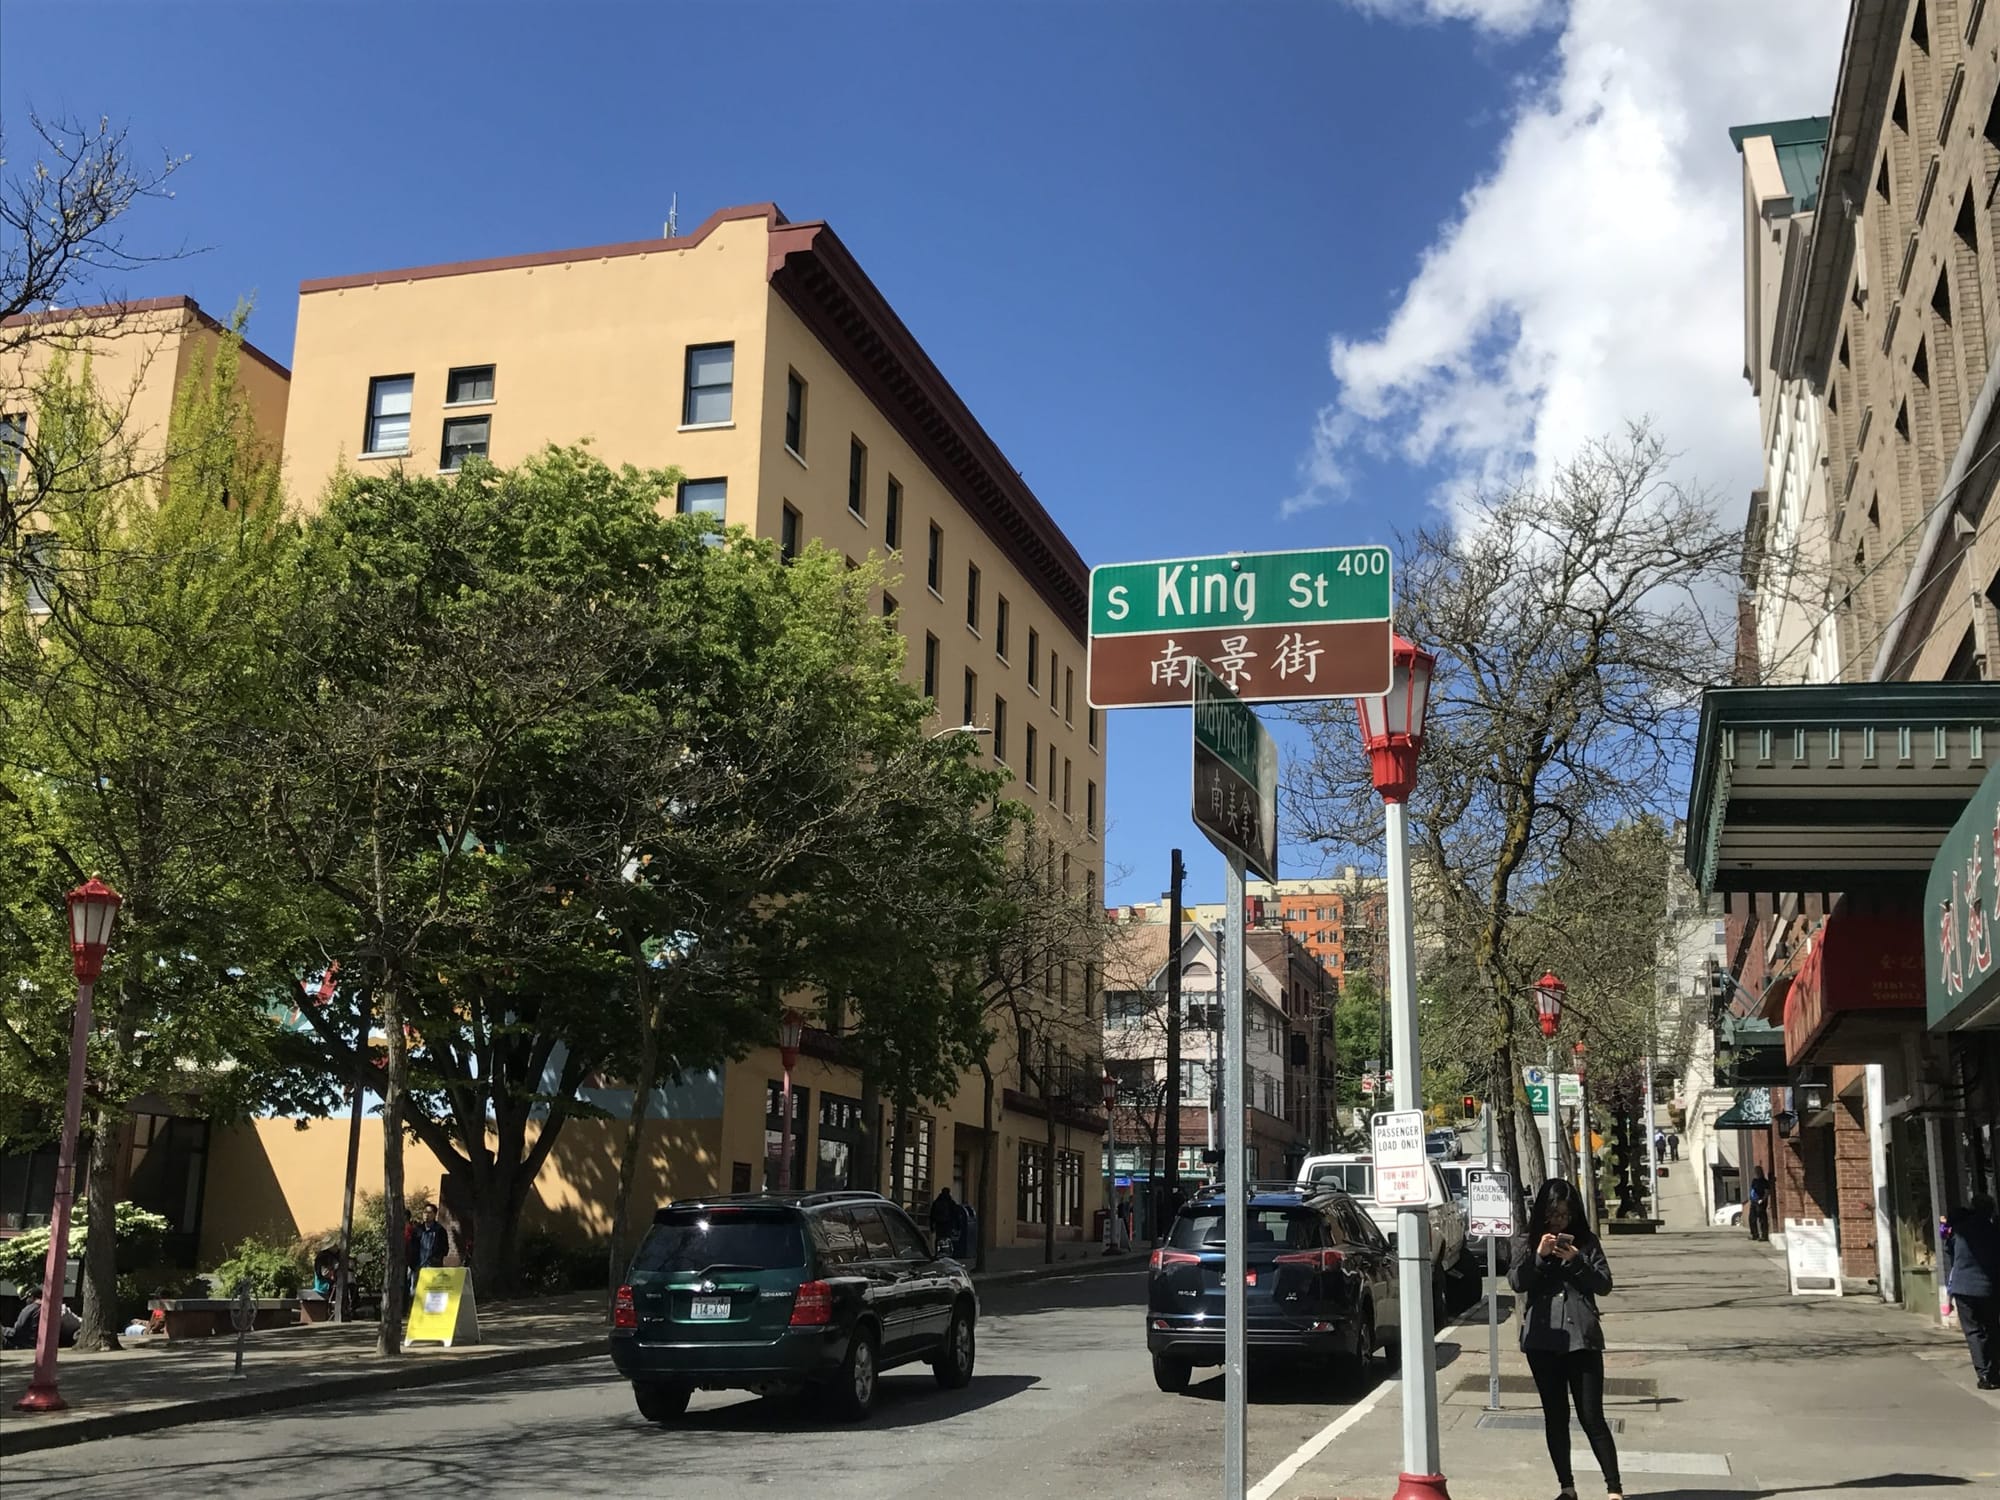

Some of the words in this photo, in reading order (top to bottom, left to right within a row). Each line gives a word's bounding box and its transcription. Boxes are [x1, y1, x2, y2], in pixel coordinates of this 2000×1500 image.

[1337, 551, 1385, 577] 400
[1107, 585, 1131, 620] S
[1157, 564, 1257, 622] King
[1288, 572, 1330, 608] St
[1150, 632, 1325, 688] 南景街
[1197, 681, 1249, 766] Maynard
[1532, 1088, 1543, 1103] 2
[1377, 1126, 1420, 1138] PASSENGER
[1378, 1140, 1398, 1152] LOAD
[1401, 1138, 1420, 1150] ONLY
[1473, 1174, 1480, 1182] 3
[1393, 1181, 1410, 1191] ZONE
[1472, 1185, 1508, 1194] PASSENGER
[1473, 1194, 1489, 1202] LOAD
